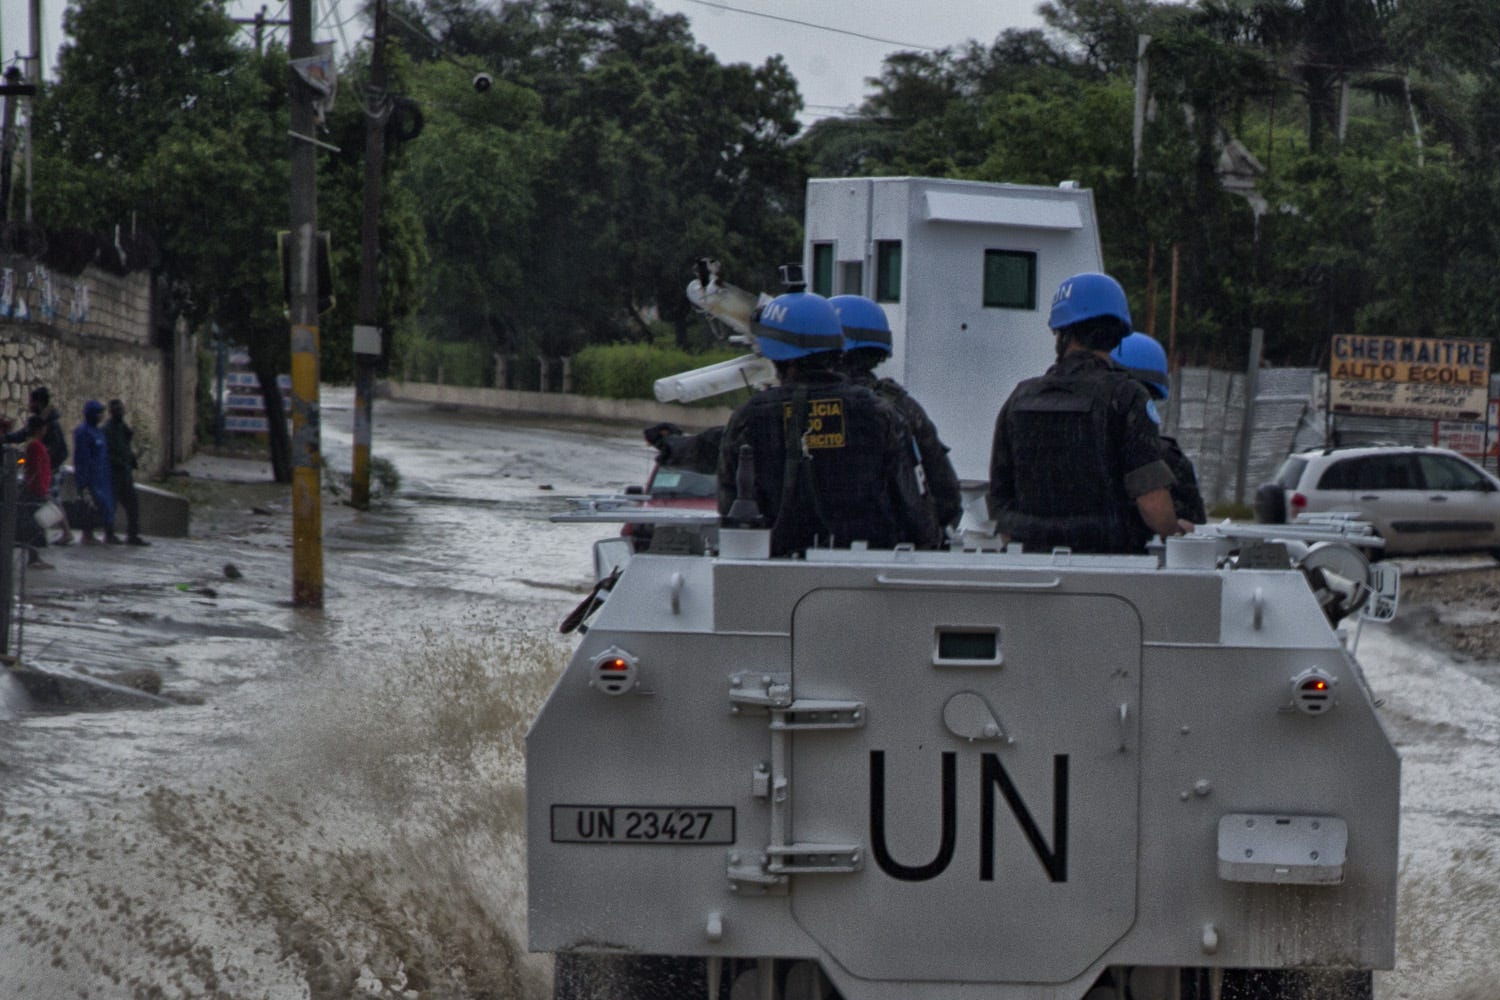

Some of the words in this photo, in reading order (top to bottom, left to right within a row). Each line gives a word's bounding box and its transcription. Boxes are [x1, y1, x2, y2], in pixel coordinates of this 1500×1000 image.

[1336, 363, 1396, 381] AUTO
[1408, 365, 1484, 386] ECOLE
[577, 809, 614, 839] UN
[625, 811, 713, 840] 23427
[869, 750, 1070, 883] UN
